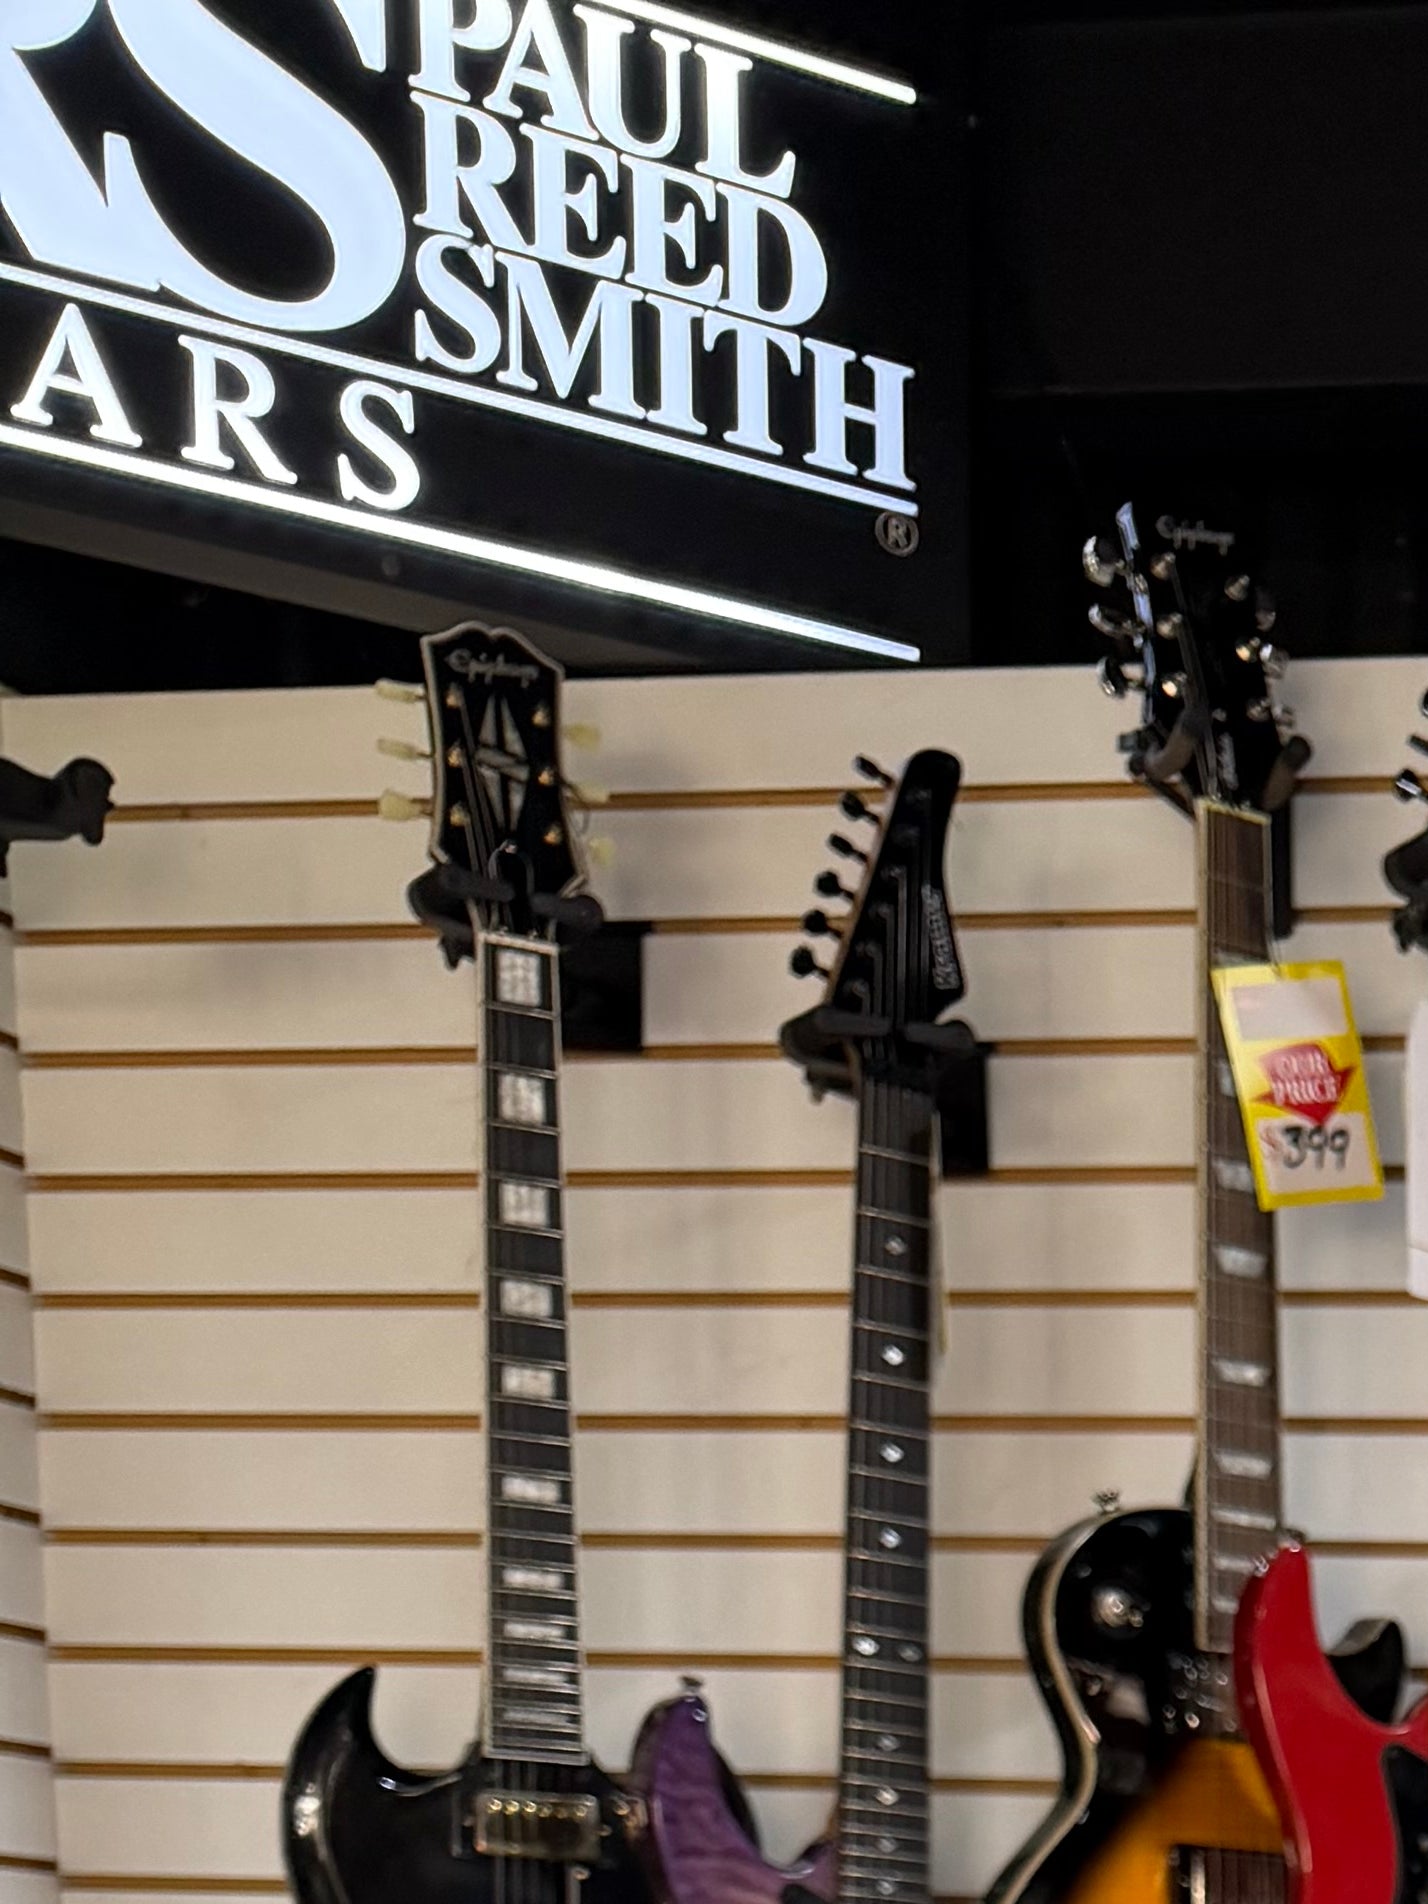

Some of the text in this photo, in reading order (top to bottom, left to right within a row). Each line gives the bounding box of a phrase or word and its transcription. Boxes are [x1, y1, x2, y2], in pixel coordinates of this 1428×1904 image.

[408, 0, 796, 199] PAUL
[410, 90, 829, 331] REED
[6, 302, 423, 512] ARS
[413, 233, 917, 492] SMITH
[1271, 1074, 1340, 1107] PRICE
